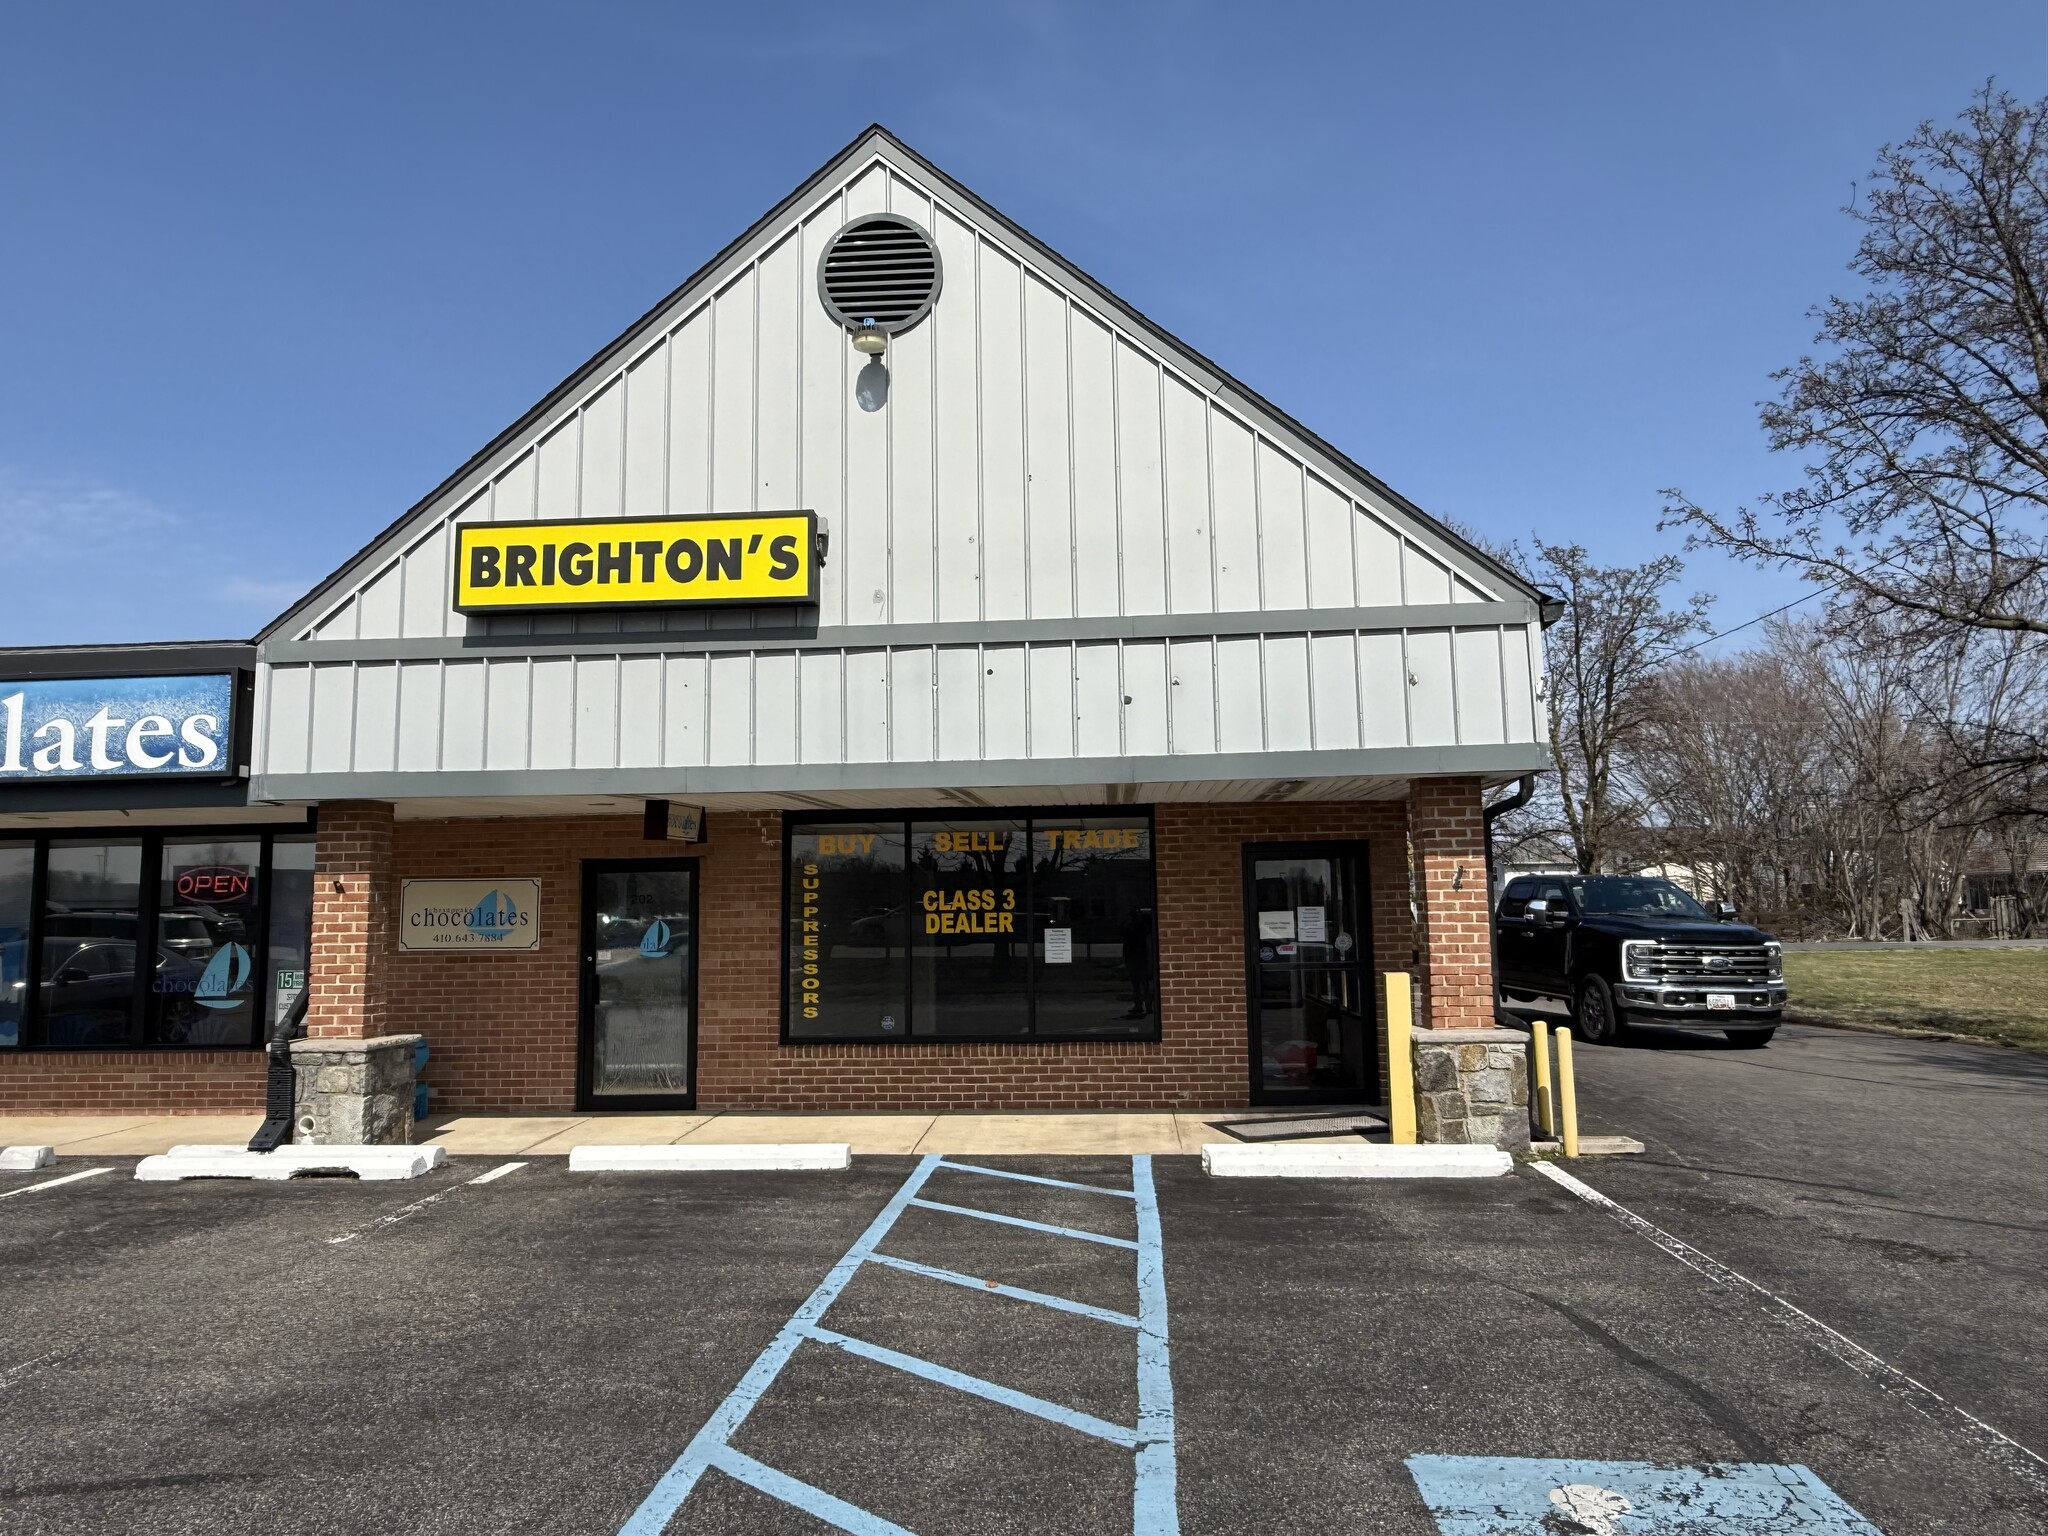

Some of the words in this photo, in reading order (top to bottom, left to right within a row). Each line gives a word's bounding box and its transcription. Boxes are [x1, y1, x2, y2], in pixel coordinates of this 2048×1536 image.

[470, 534, 800, 588] BRIGHTON'S
[0, 692, 218, 772] lates
[818, 834, 876, 855] BUY
[934, 832, 1003, 852] SELL
[1044, 829, 1141, 849] TRADE
[177, 875, 249, 894] OPEN
[631, 894, 654, 904] 202
[923, 889, 995, 911] CLASS
[1002, 888, 1016, 910] 3
[411, 908, 528, 927] chocolates
[925, 911, 1014, 934] DEALER
[433, 933, 504, 943] 410.643.7884
[801, 864, 820, 1019] SUPPRESSORS
[279, 972, 293, 988] 15
